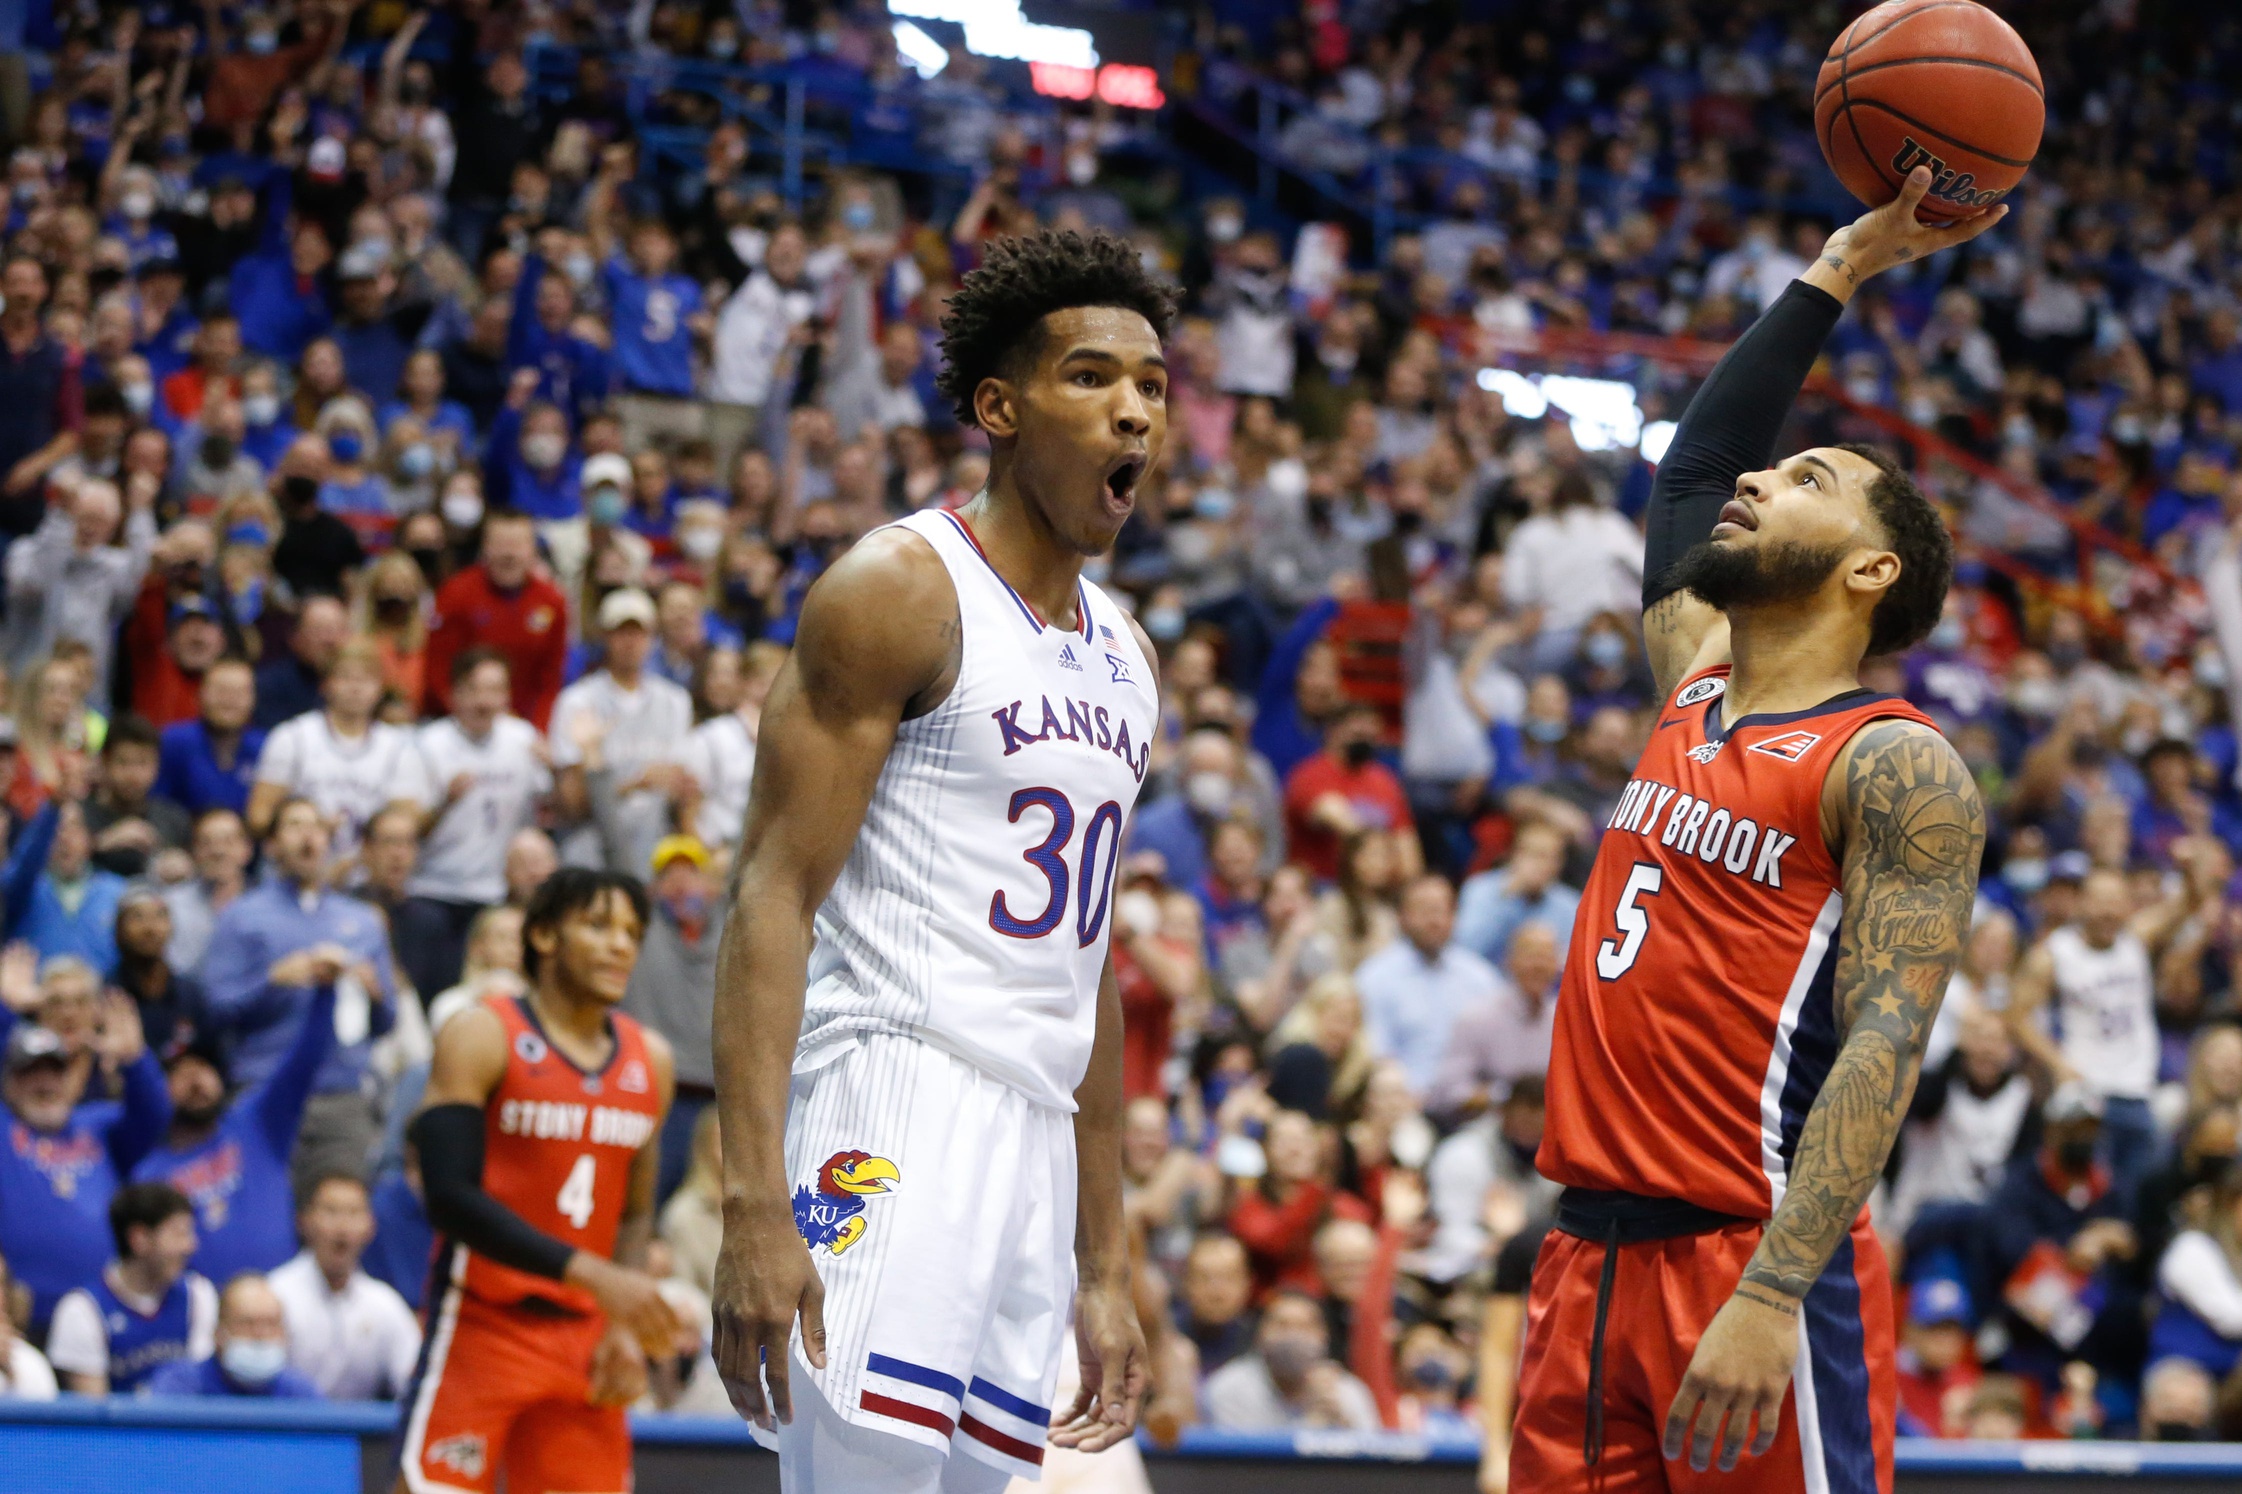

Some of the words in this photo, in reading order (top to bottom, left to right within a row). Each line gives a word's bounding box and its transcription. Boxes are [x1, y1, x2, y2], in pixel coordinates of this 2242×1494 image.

[1057, 659, 1084, 672] adidas
[992, 694, 1150, 784] KANSAS
[989, 786, 1122, 950] 30
[1606, 778, 1679, 837] TONY
[1660, 793, 1798, 891] BROOK
[1595, 860, 1663, 983] 5
[556, 1154, 597, 1230] 4
[807, 1204, 840, 1227] KU
